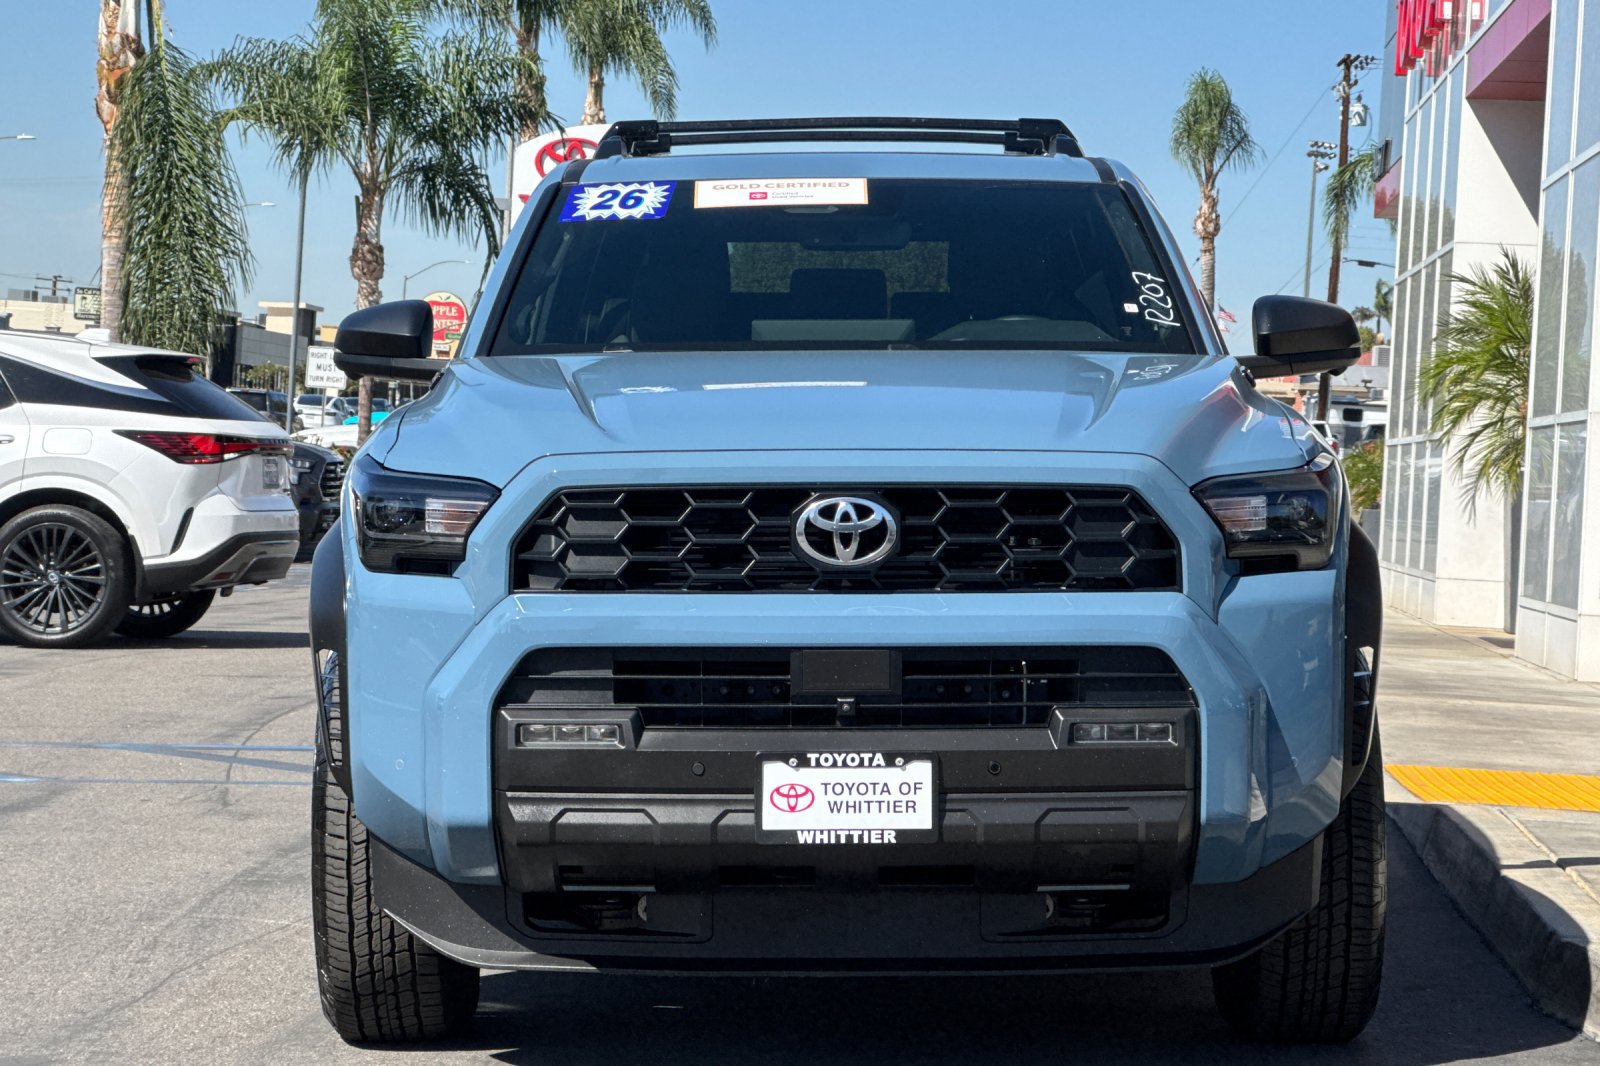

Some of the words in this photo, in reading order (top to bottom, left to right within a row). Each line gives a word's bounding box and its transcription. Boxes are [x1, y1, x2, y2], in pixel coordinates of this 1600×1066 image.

[764, 181, 850, 189] CERTIFIED
[590, 189, 648, 210] 26
[433, 305, 458, 317] PPLE
[433, 319, 459, 330] NTER
[807, 753, 885, 767] TOYOTA
[821, 782, 891, 796] TOYOTA
[898, 782, 923, 796] OF
[827, 800, 917, 814] WHITTIER
[797, 830, 896, 844] WHITTIER
